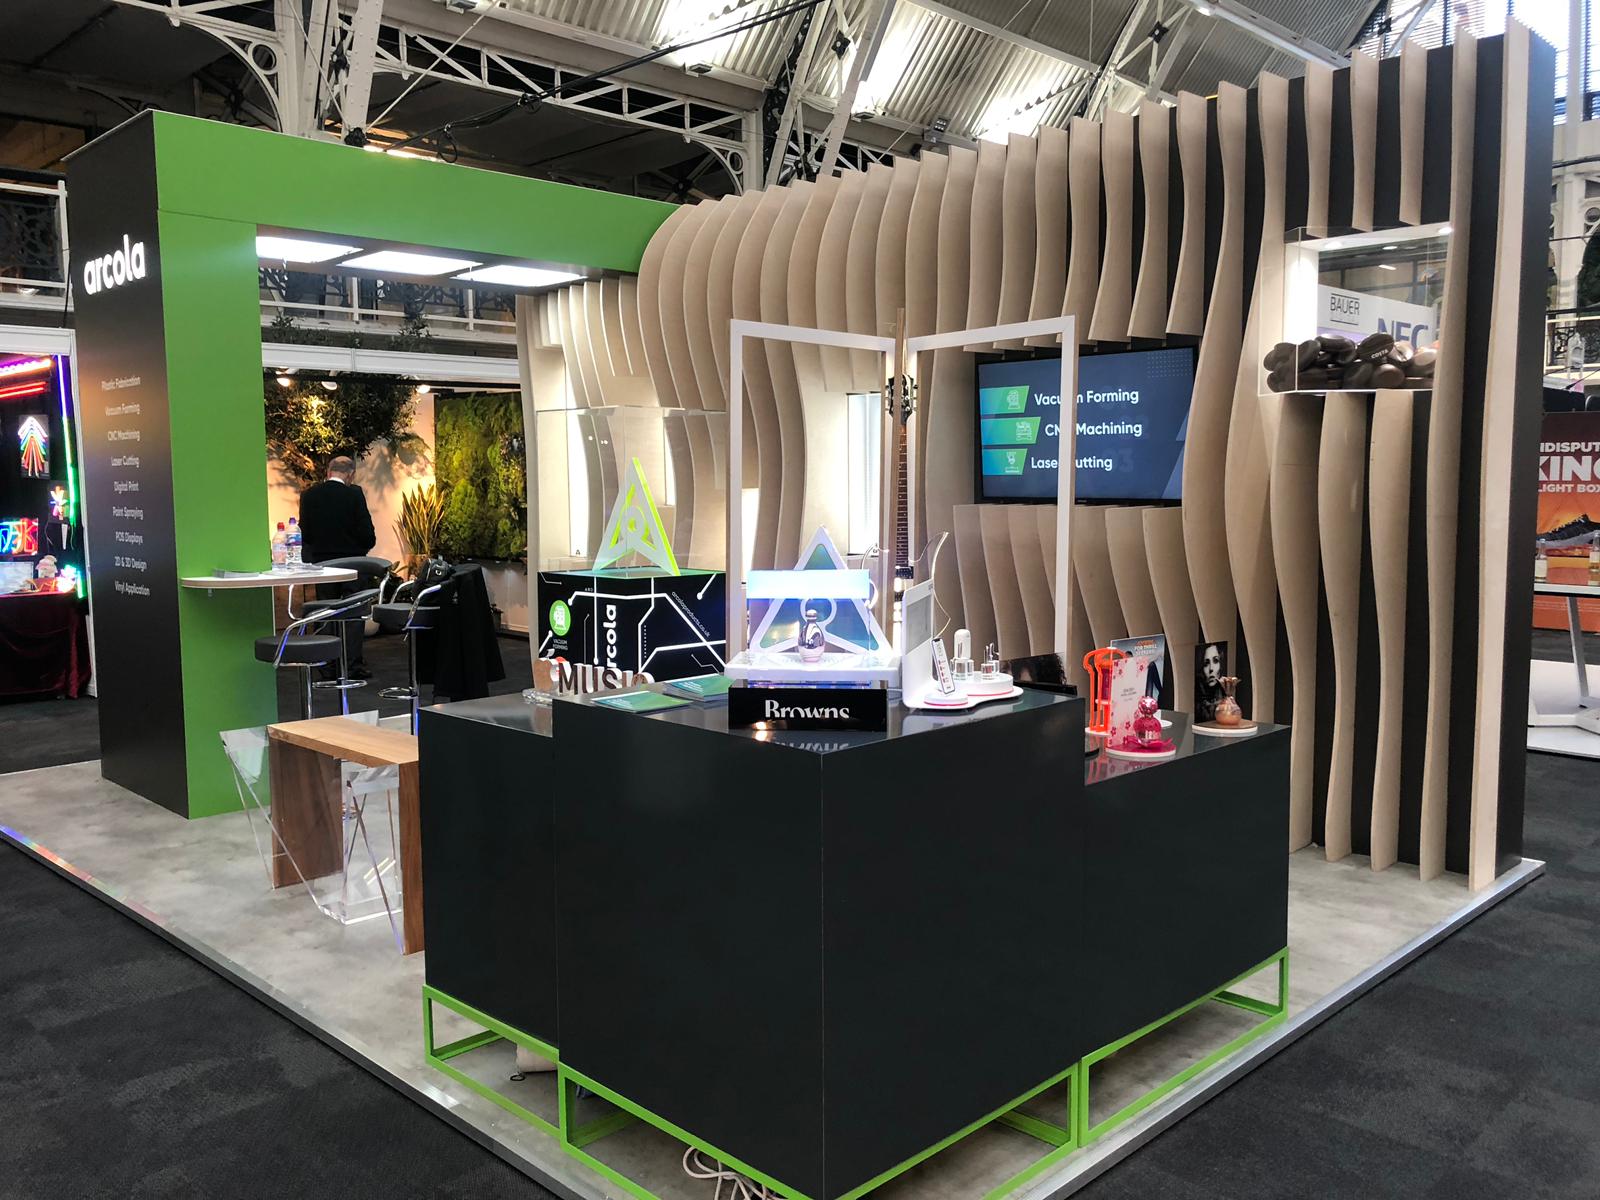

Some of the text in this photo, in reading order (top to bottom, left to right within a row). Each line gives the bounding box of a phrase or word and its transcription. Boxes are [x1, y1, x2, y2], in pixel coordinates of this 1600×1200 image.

[84, 234, 146, 295] arcola
[1330, 296, 1360, 315] BAUER
[116, 376, 141, 388] Fabrication
[1086, 389, 1139, 404] Forming
[122, 403, 140, 415] Forming
[108, 430, 140, 441] CNC Machining
[1045, 423, 1061, 436] CN
[1076, 421, 1142, 437] Machining
[111, 455, 140, 468] Laser Cutting
[1031, 457, 1058, 468] Lase
[1075, 456, 1113, 471] utting
[114, 481, 139, 494] Digital Print
[112, 506, 143, 520] Paint Spraying
[116, 531, 143, 545] POS Displays
[115, 556, 120, 566] 2D
[125, 557, 131, 568] 3D
[132, 558, 147, 572] Design
[115, 581, 150, 596] Vinyl Application
[672, 591, 711, 638] arcolaproducts.co.uk
[602, 604, 617, 668] rcola
[765, 700, 850, 719] Browns
